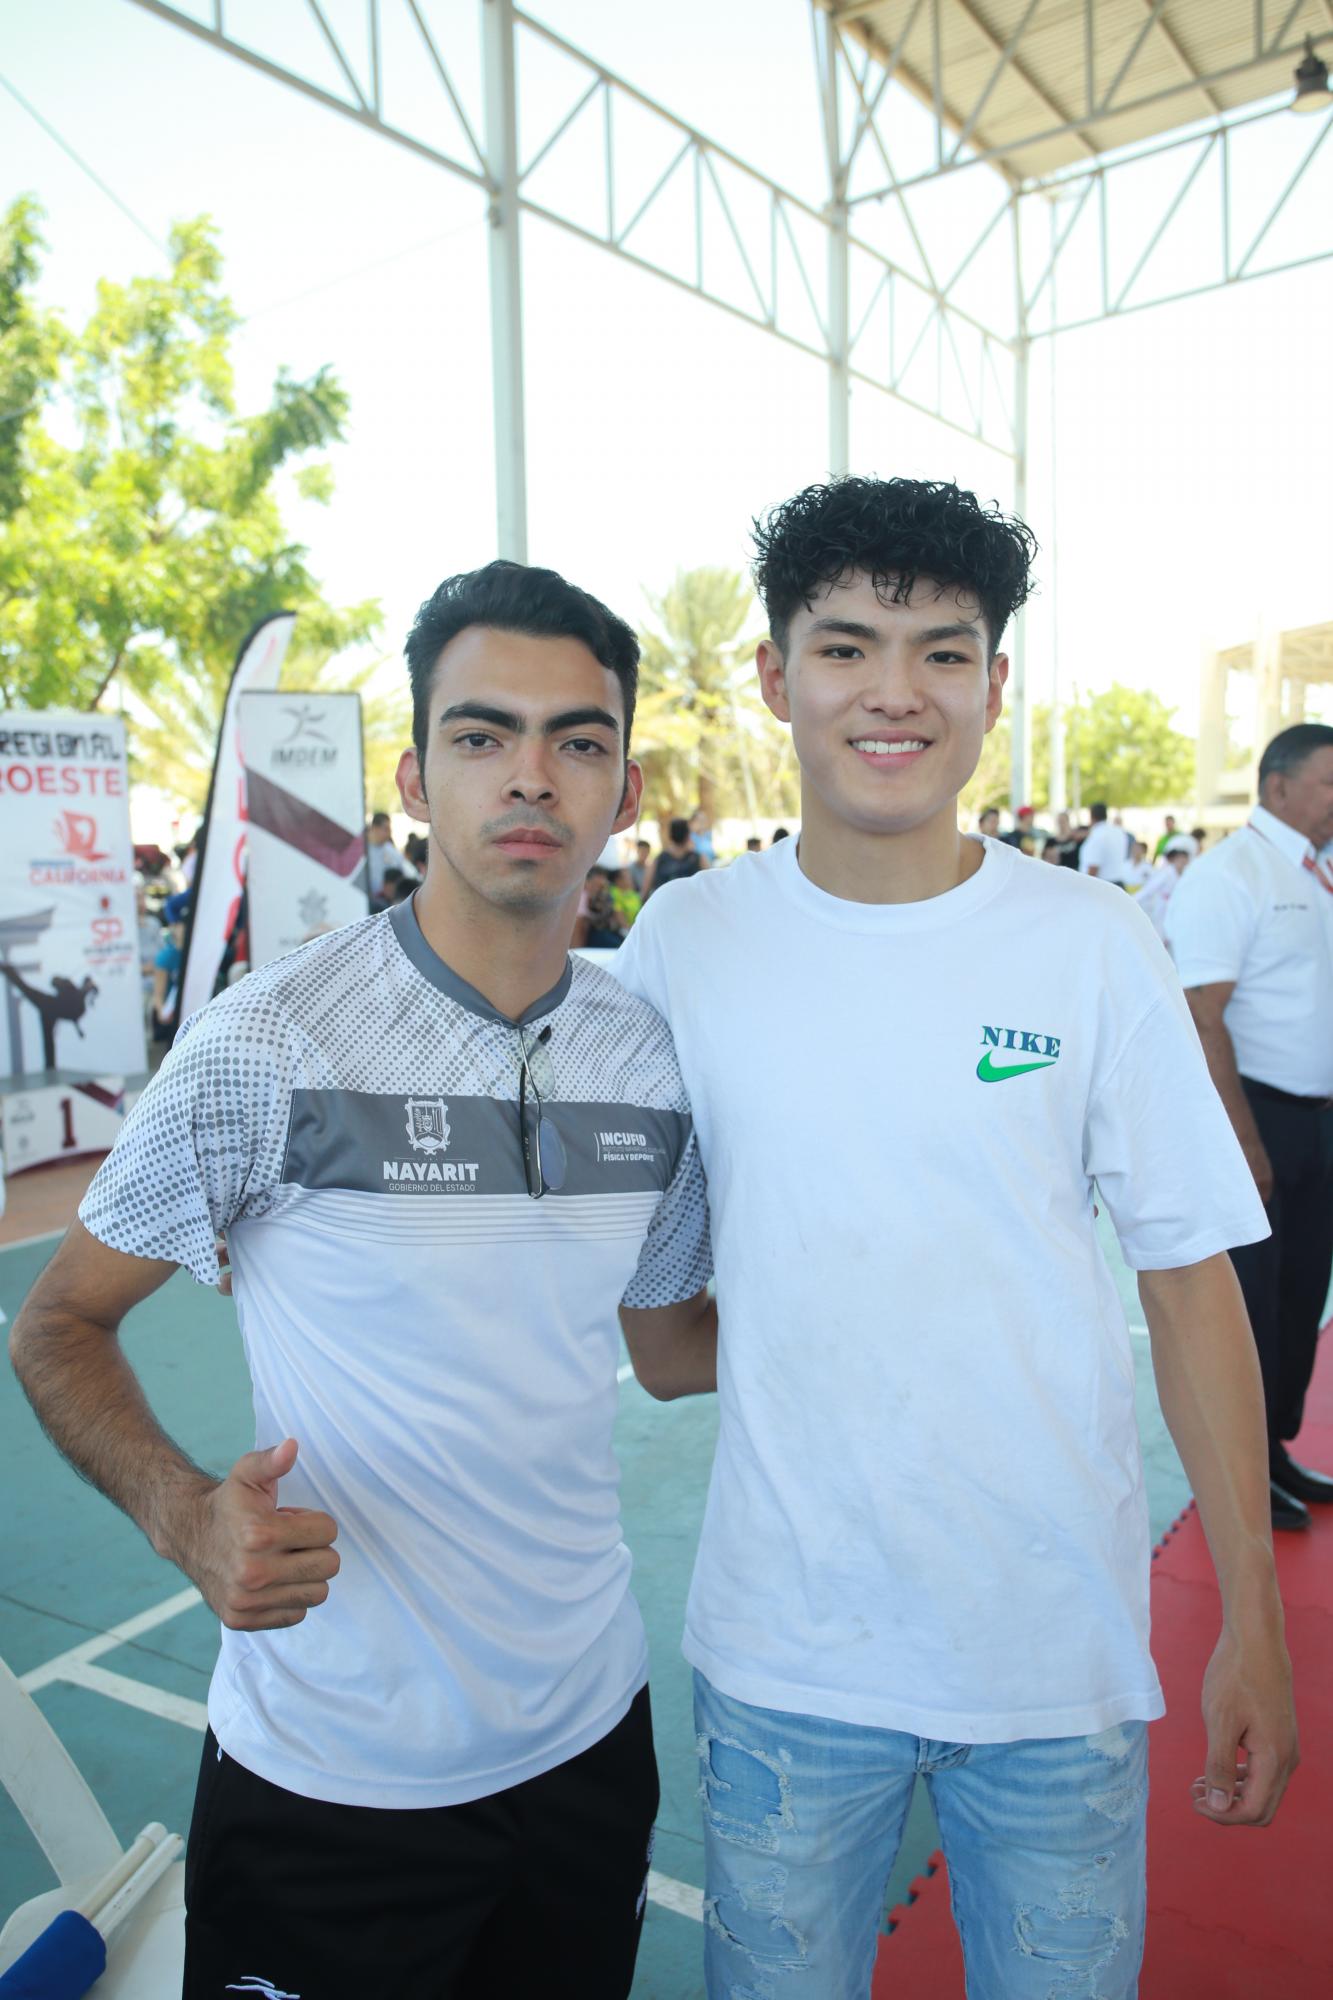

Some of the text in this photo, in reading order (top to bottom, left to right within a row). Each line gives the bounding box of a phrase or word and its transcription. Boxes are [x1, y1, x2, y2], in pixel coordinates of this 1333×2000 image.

[0, 764, 122, 797] OESTE
[29, 868, 127, 886] CALIFORNIA
[980, 1025, 1061, 1059] NIKE
[59, 1096, 78, 1149] 1
[599, 1132, 647, 1147] INCUFID
[383, 1161, 480, 1181] NAYARIT
[388, 1183, 476, 1192] GOBIERNO DEL ESTADO
